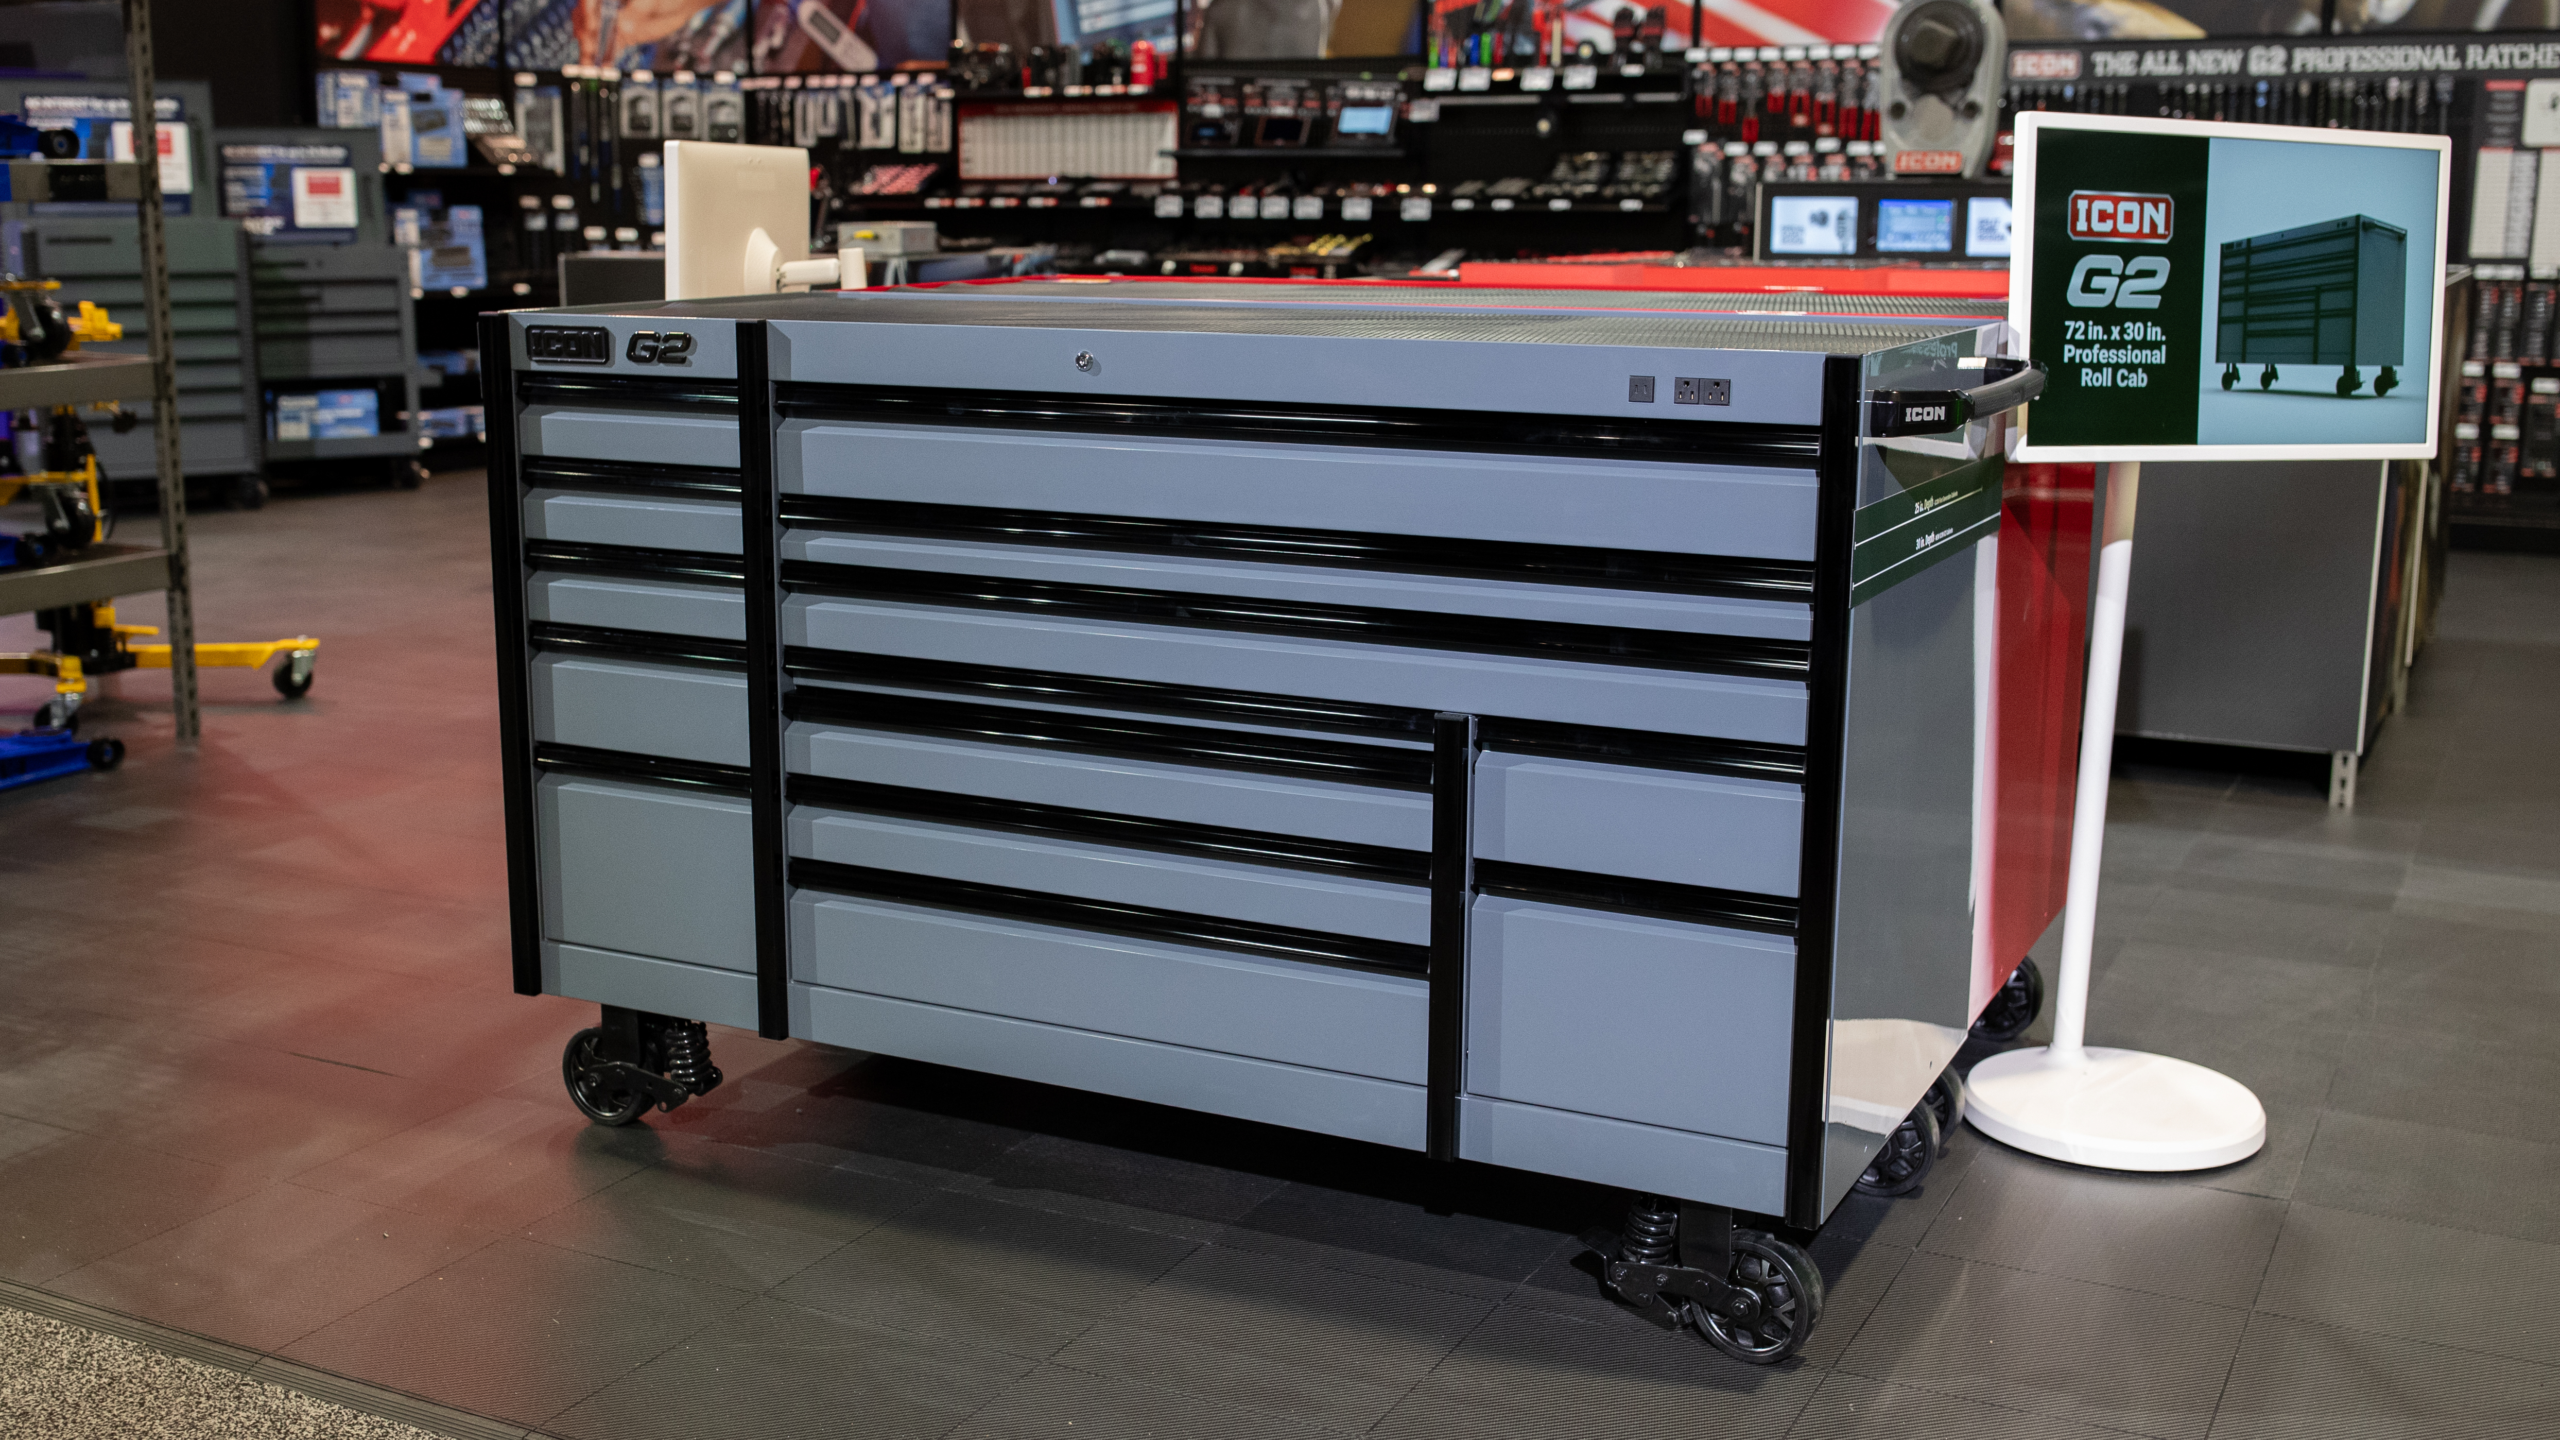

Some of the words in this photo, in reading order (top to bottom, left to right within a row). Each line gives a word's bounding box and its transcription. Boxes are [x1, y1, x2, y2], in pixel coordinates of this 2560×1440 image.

[2012, 54, 2077, 77] ICON
[2091, 51, 2138, 76] THE
[2139, 50, 2183, 76] ALL
[2186, 49, 2243, 75] NEW
[2247, 44, 2288, 76] G2
[2291, 44, 2462, 73] PROFESSIONAL
[1900, 153, 1958, 171] ICON
[2076, 199, 2166, 234] ICON
[2066, 254, 2171, 309] G2
[2064, 320, 2086, 340] 72
[2087, 320, 2108, 340] in.
[2110, 325, 2121, 341] x
[2123, 321, 2144, 341] 30
[2146, 321, 2166, 341] in.
[530, 329, 602, 358] ICON
[626, 330, 692, 364] G2
[2063, 343, 2167, 365] Professional
[2081, 367, 2112, 387] Roll
[2116, 367, 2148, 388] Cab
[1905, 406, 1946, 422] ICON
